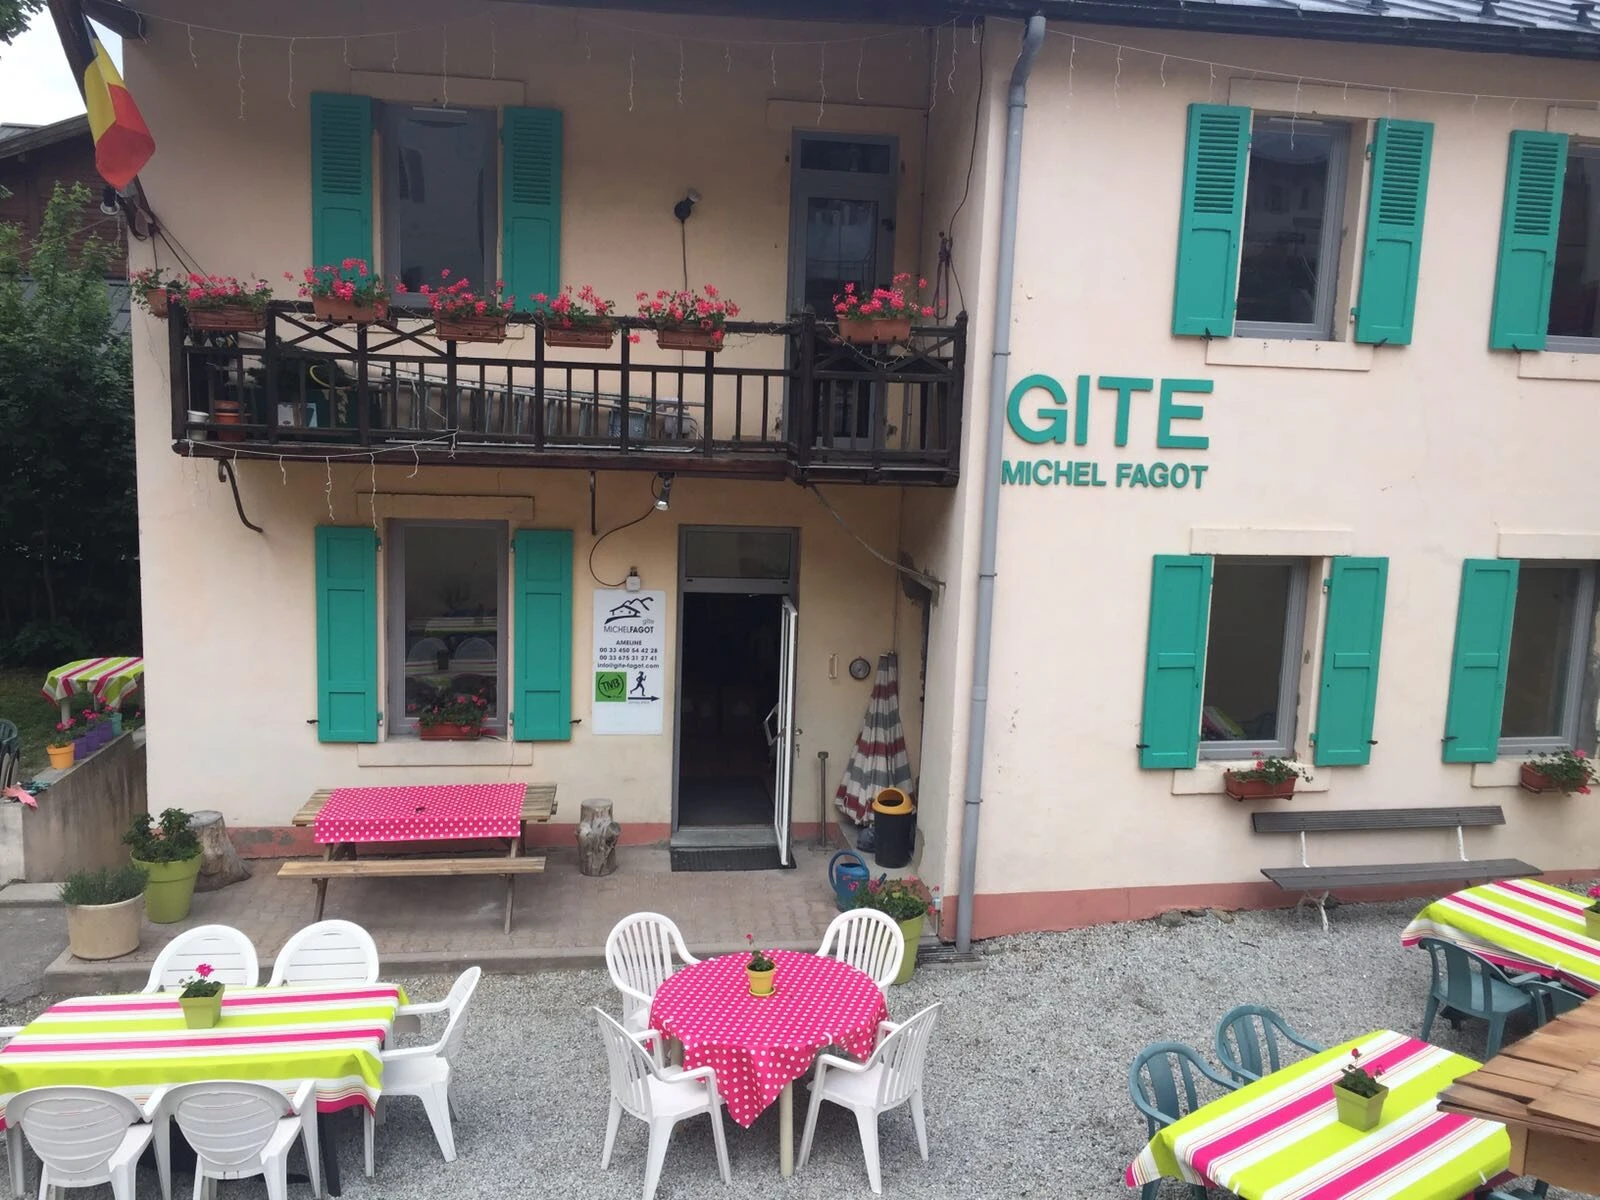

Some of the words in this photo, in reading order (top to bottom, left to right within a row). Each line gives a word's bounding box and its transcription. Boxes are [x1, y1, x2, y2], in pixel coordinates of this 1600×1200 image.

[1007, 374, 1214, 449] GITE
[1001, 459, 1106, 486] MICHEL
[1115, 462, 1209, 489] FAGOT
